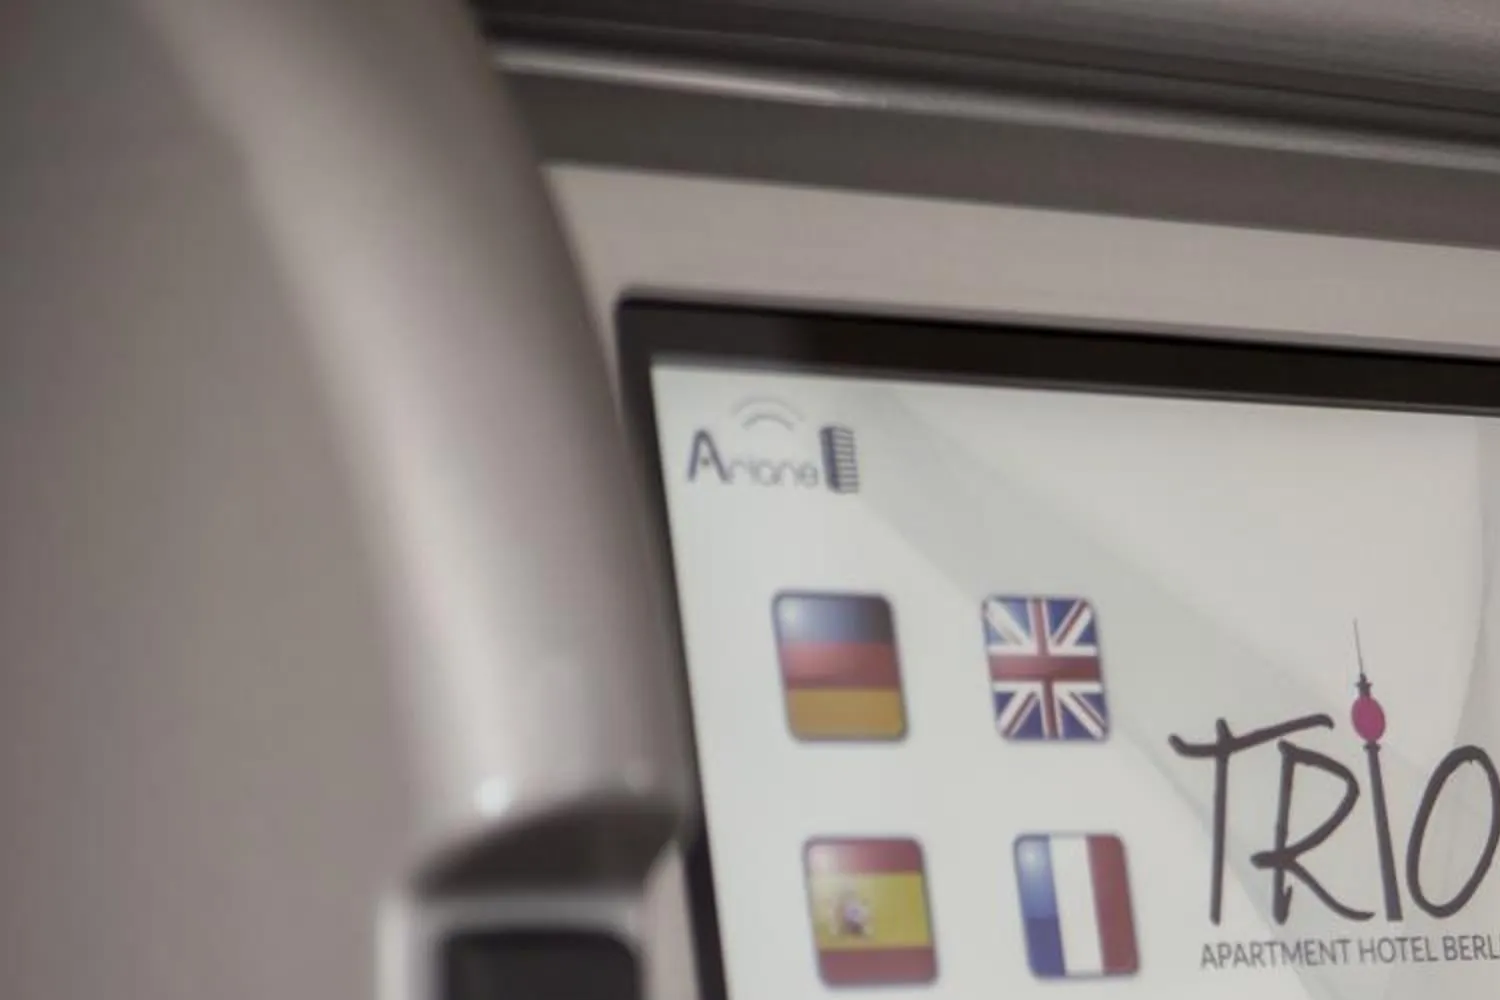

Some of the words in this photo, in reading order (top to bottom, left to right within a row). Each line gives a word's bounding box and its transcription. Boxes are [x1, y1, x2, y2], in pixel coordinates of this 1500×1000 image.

[686, 428, 820, 488] Ariane
[1200, 938, 1352, 970] APARTMENT
[1358, 936, 1438, 964] HOTEL
